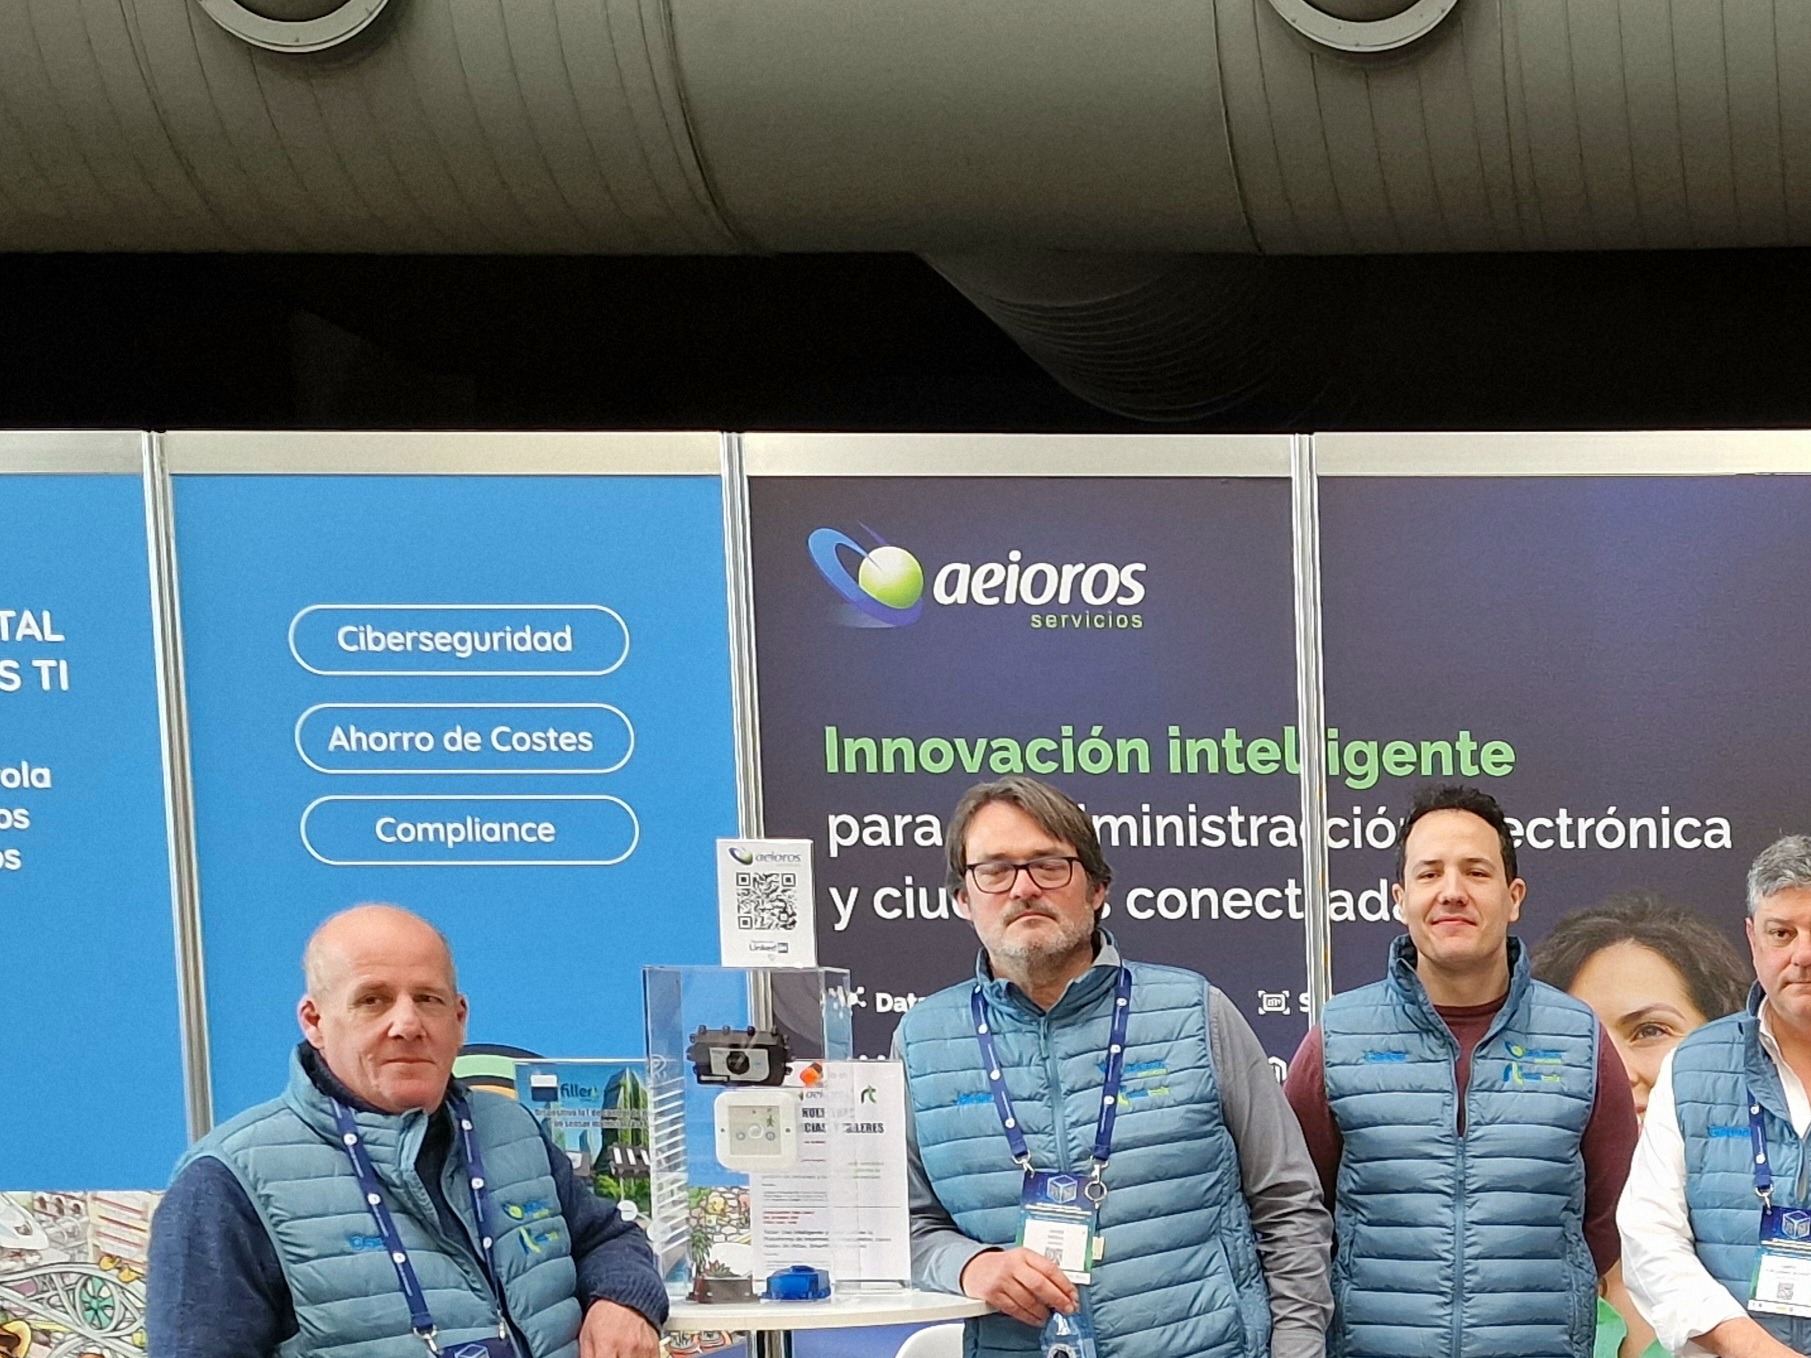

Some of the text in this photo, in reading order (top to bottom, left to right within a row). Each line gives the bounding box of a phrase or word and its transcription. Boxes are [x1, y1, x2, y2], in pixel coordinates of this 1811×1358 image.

[933, 549, 1147, 606] aeioros
[1030, 610, 1143, 629] servicios
[337, 625, 573, 658] Ciberseguridad
[32, 659, 69, 690] TI
[329, 725, 593, 753] Ahorro de Costes
[825, 725, 1151, 774] Innovación
[0, 761, 51, 788] ola
[375, 816, 555, 847] Compliance
[828, 814, 943, 857] para
[1503, 806, 1732, 850] ectrónica
[829, 887, 858, 931] y
